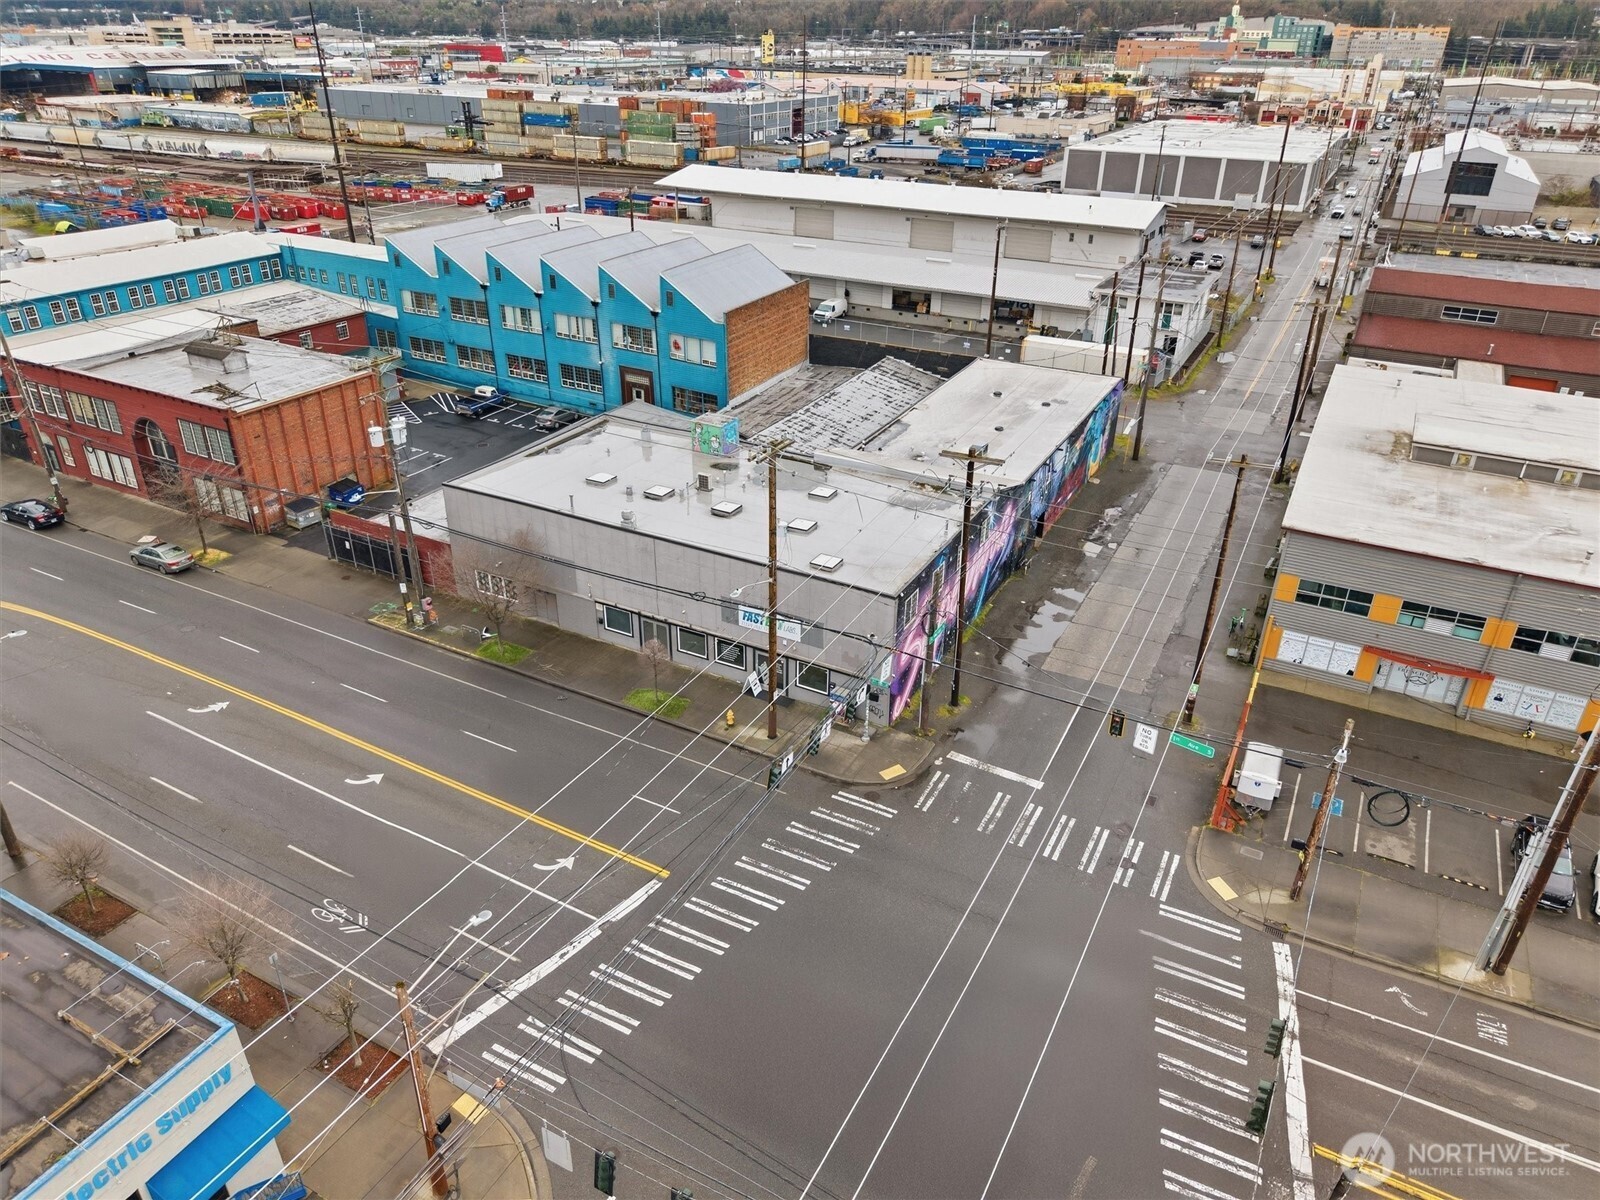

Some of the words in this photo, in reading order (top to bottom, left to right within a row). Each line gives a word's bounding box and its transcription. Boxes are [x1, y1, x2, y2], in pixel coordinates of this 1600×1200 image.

[86, 52, 187, 60] CENTER
[1140, 733, 1152, 741] TURN
[1187, 742, 1199, 750] Ave
[155, 1063, 232, 1136] Supply
